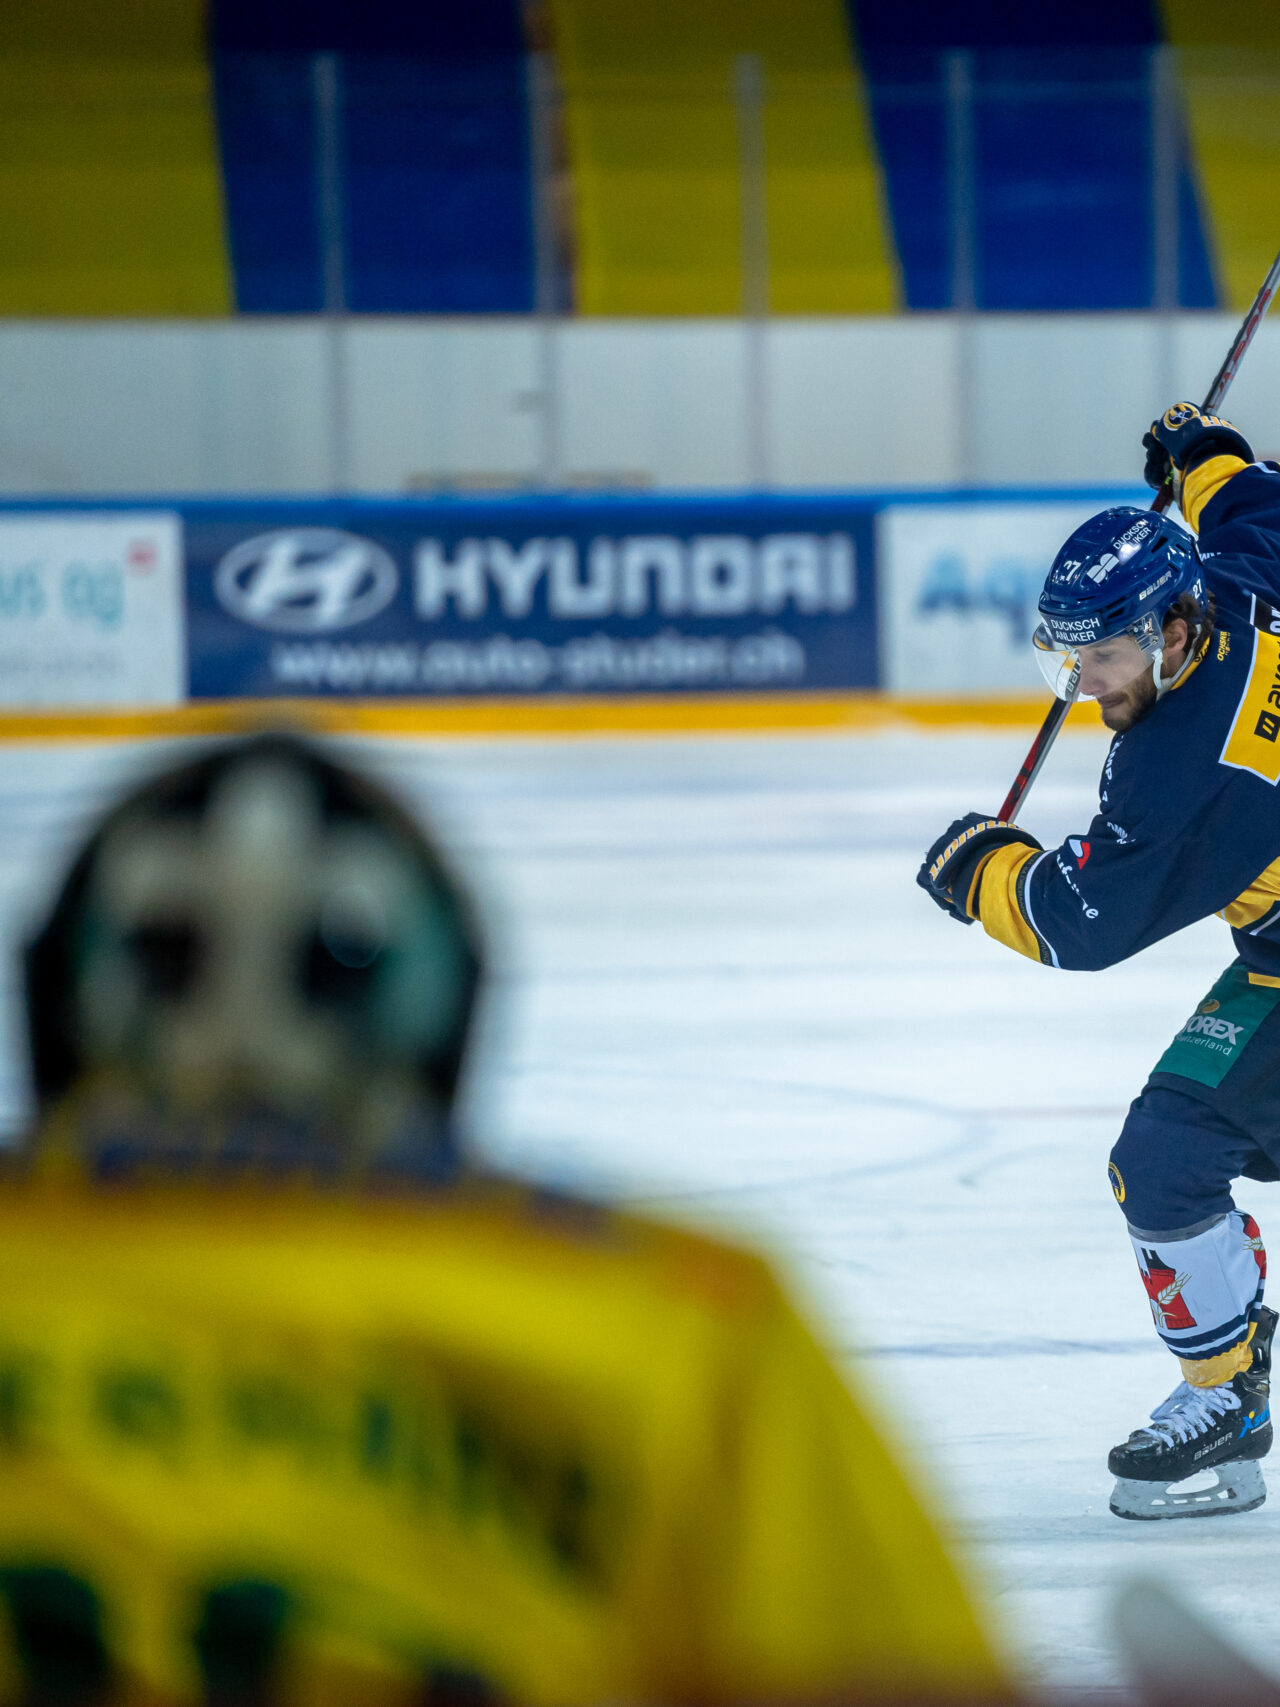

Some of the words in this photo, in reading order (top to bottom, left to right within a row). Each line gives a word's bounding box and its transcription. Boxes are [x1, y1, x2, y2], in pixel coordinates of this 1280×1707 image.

[414, 534, 855, 619] HYUNDAI
[1139, 571, 1172, 600] BAUER
[1193, 579, 1202, 599] 27
[1051, 617, 1100, 631] DUCKSCH
[1056, 631, 1096, 642] ANLIKER
[1194, 1432, 1233, 1461] BAUER
